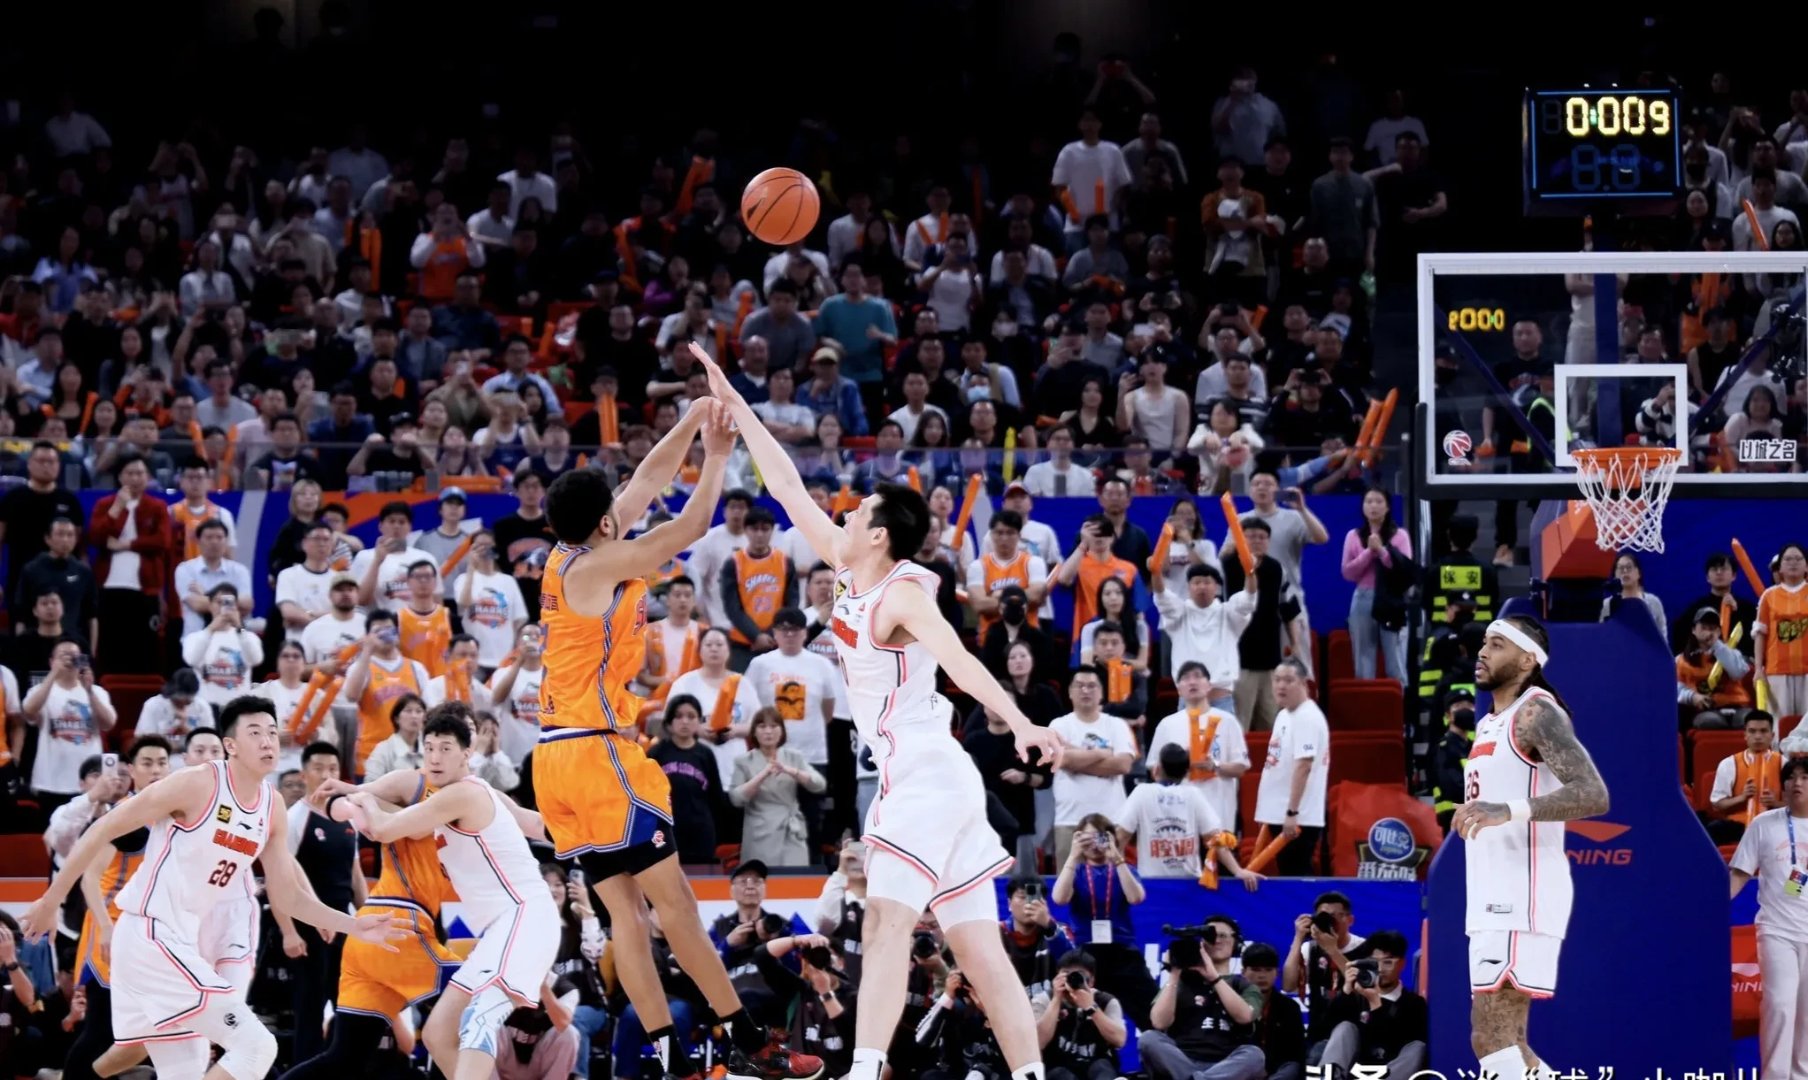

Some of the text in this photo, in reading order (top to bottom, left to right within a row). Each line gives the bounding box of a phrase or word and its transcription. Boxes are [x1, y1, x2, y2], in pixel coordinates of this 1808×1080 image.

[1740, 440, 1797, 461] 以城之名
[1443, 570, 1480, 585] 保安
[208, 859, 238, 888] 28
